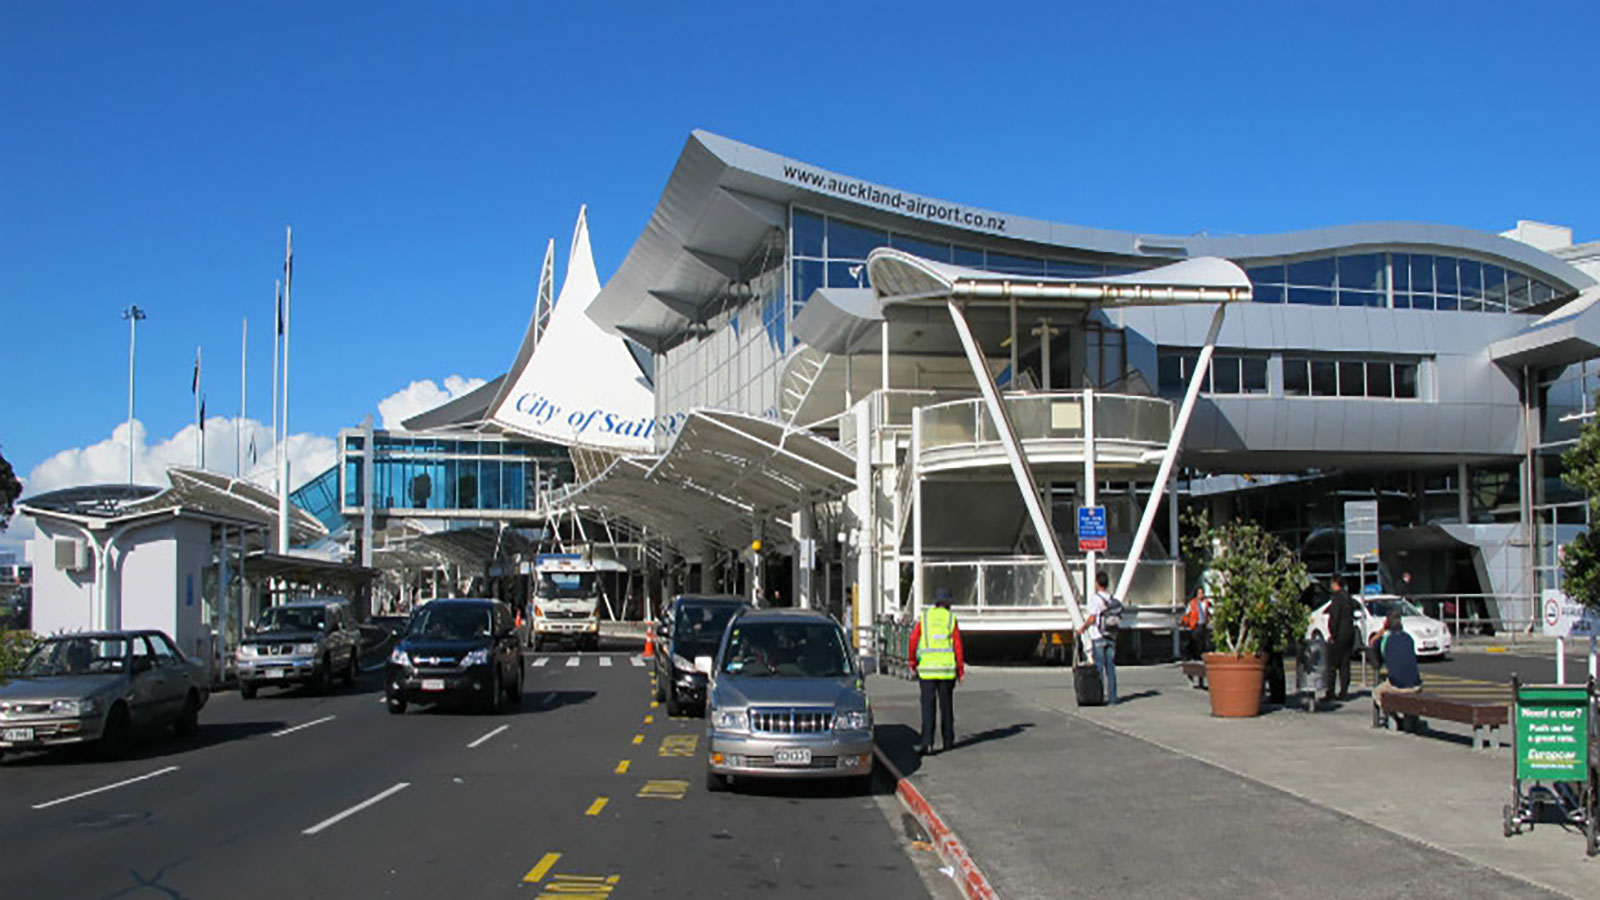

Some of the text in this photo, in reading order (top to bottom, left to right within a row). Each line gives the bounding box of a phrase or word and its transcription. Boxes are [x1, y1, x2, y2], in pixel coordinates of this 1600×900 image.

[783, 162, 1006, 233] www.auckland-airport.co.nz
[515, 392, 655, 438] City of Sail
[1521, 707, 1549, 718] Need
[1559, 708, 1582, 719] car?
[1528, 748, 1576, 761] Europcar
